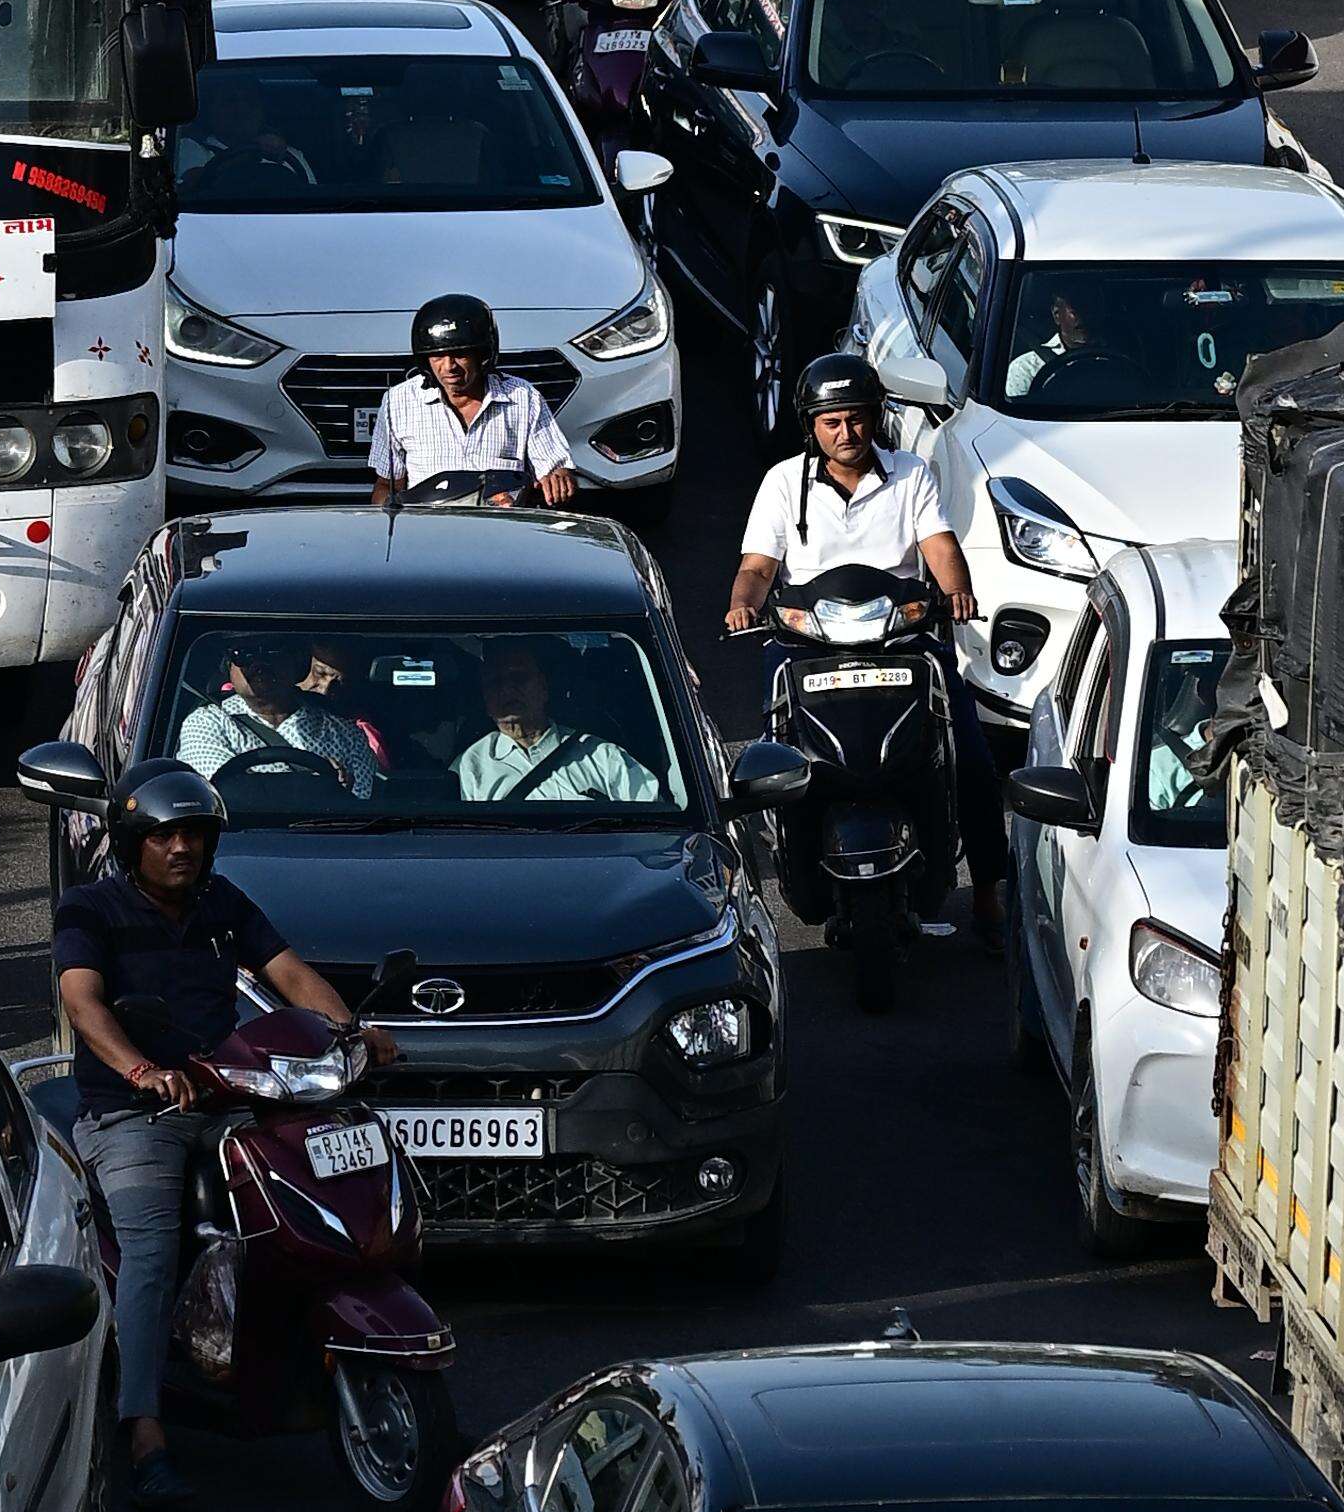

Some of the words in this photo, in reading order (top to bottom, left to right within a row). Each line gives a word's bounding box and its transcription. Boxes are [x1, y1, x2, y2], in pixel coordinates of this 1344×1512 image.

[2, 218, 53, 234] लाभ
[322, 1128, 371, 1157] RJ14K
[330, 1145, 376, 1171] Z3467
